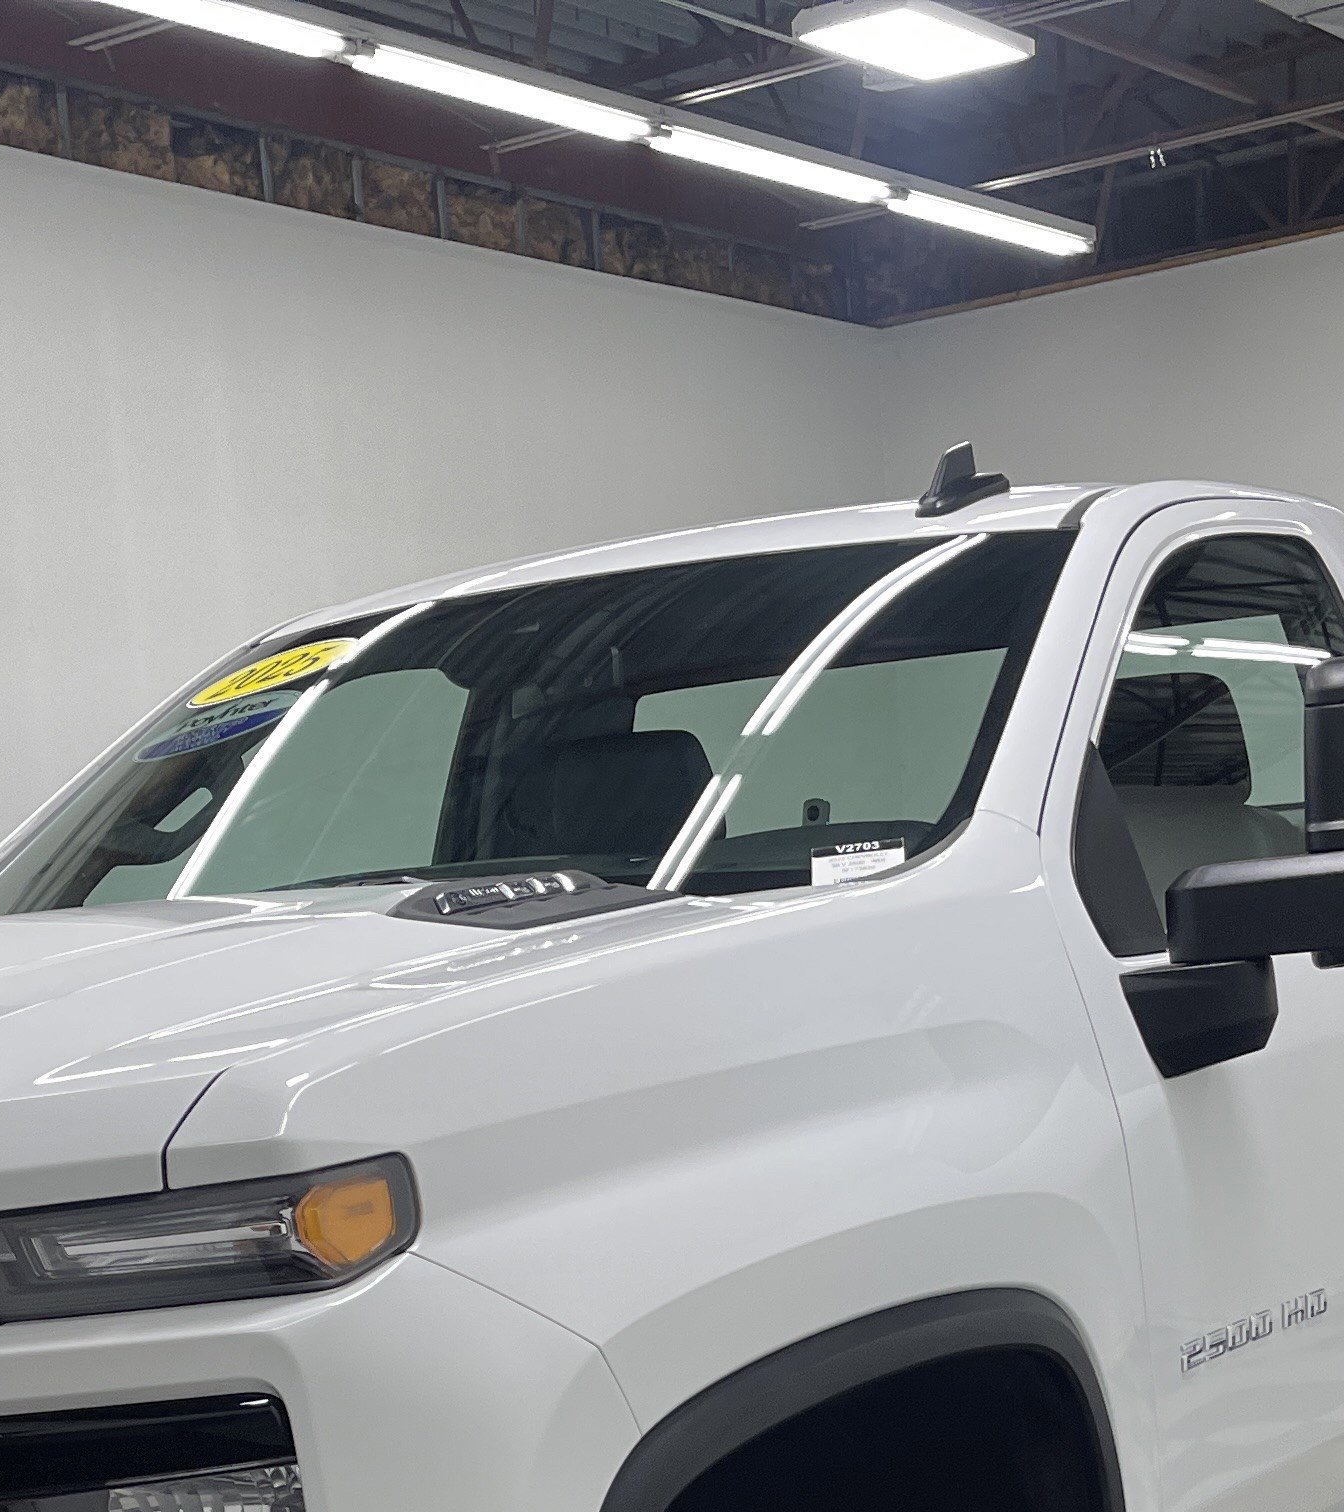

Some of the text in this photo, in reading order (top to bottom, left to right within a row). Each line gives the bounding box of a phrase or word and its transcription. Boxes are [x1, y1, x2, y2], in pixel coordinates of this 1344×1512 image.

[206, 645, 340, 700] 2025
[835, 840, 880, 853] V2703
[1179, 1287, 1328, 1374] 2500 HD
